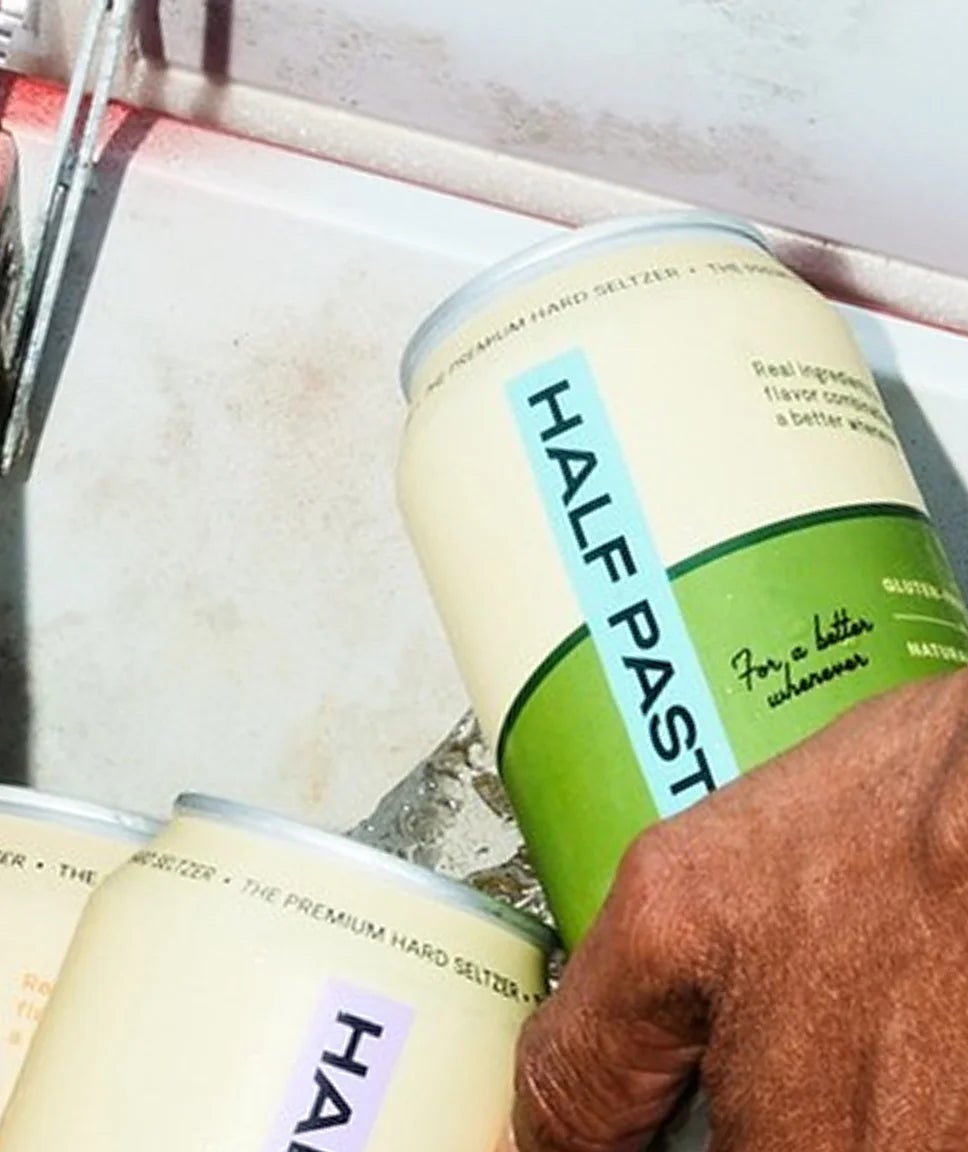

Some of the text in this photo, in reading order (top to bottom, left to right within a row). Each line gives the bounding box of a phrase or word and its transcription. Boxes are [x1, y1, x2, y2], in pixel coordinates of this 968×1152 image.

[531, 290, 588, 324] HARD
[593, 266, 680, 298] SELTZER
[751, 359, 796, 378] Real
[763, 385, 818, 402] flavor
[775, 412, 788, 428] a
[789, 408, 843, 429] better
[527, 379, 717, 797] HALF PAST
[731, 607, 874, 692] For a better
[766, 652, 869, 708] whenever
[58, 862, 97, 886] THE
[242, 878, 278, 902] THE
[282, 892, 387, 941] PREMIUM
[390, 932, 449, 968] HARD
[453, 957, 521, 1003] SELTZER
